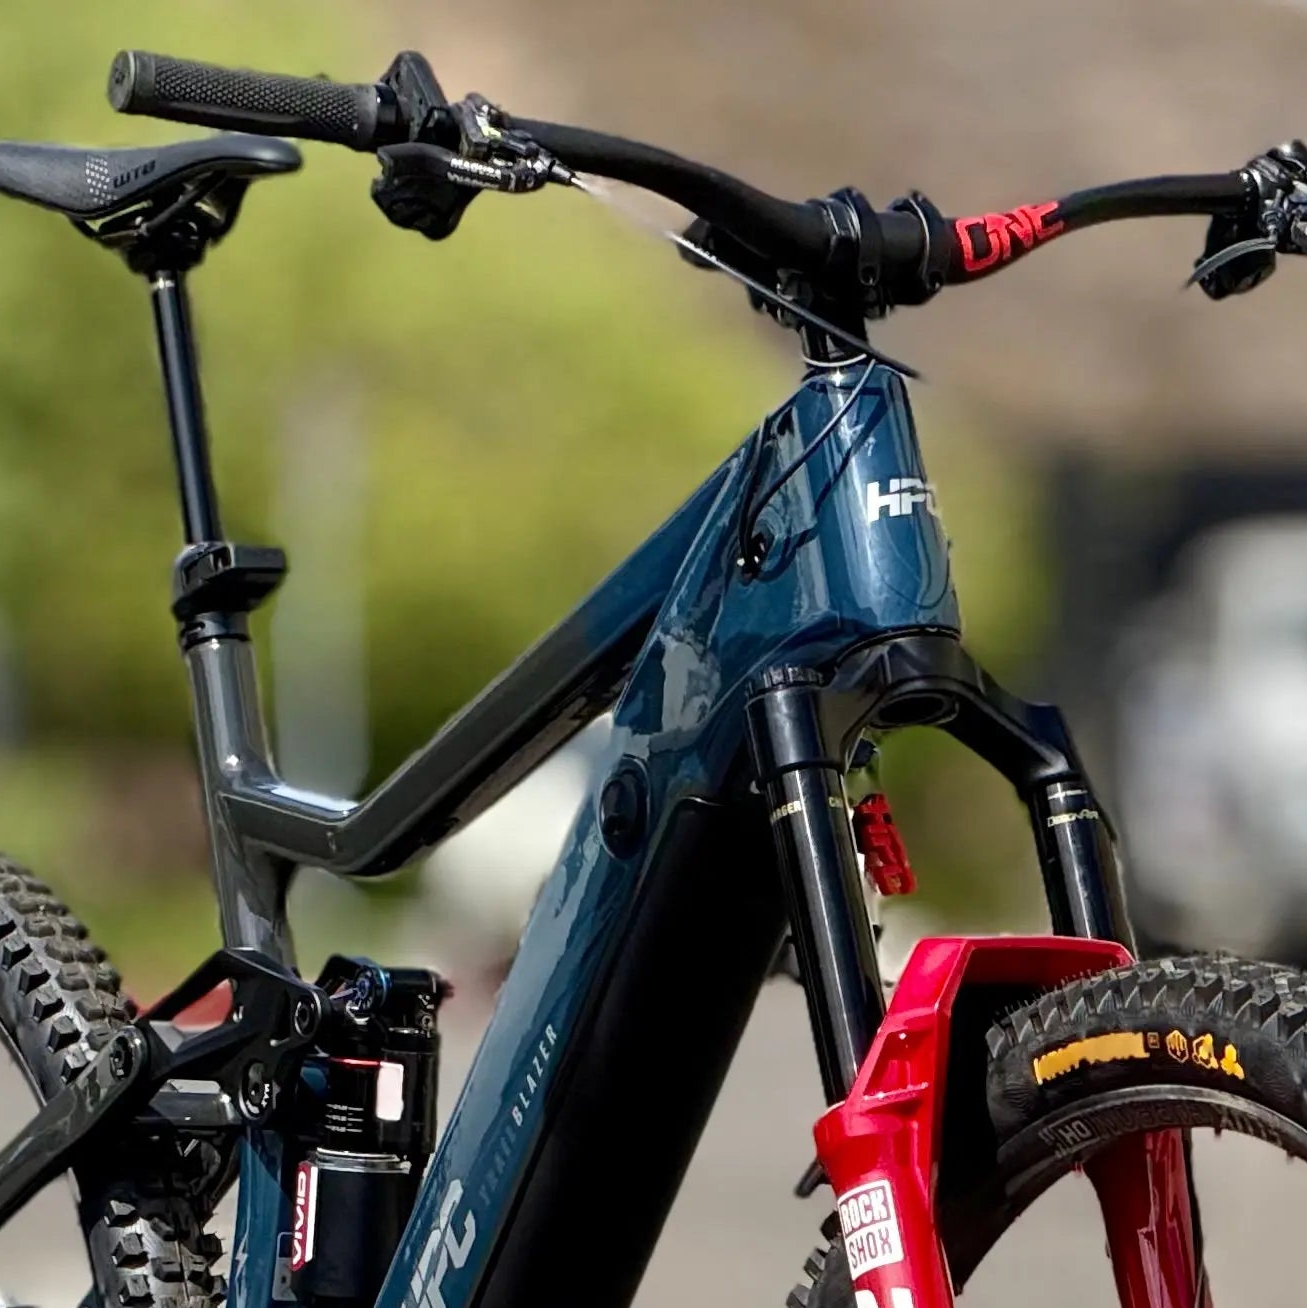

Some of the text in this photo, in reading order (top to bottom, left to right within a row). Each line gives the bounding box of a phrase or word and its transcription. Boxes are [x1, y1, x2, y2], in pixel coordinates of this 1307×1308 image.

[293, 1171, 306, 1265] VIVID
[840, 1188, 888, 1234] ROCK
[848, 1226, 893, 1269] SHOX
